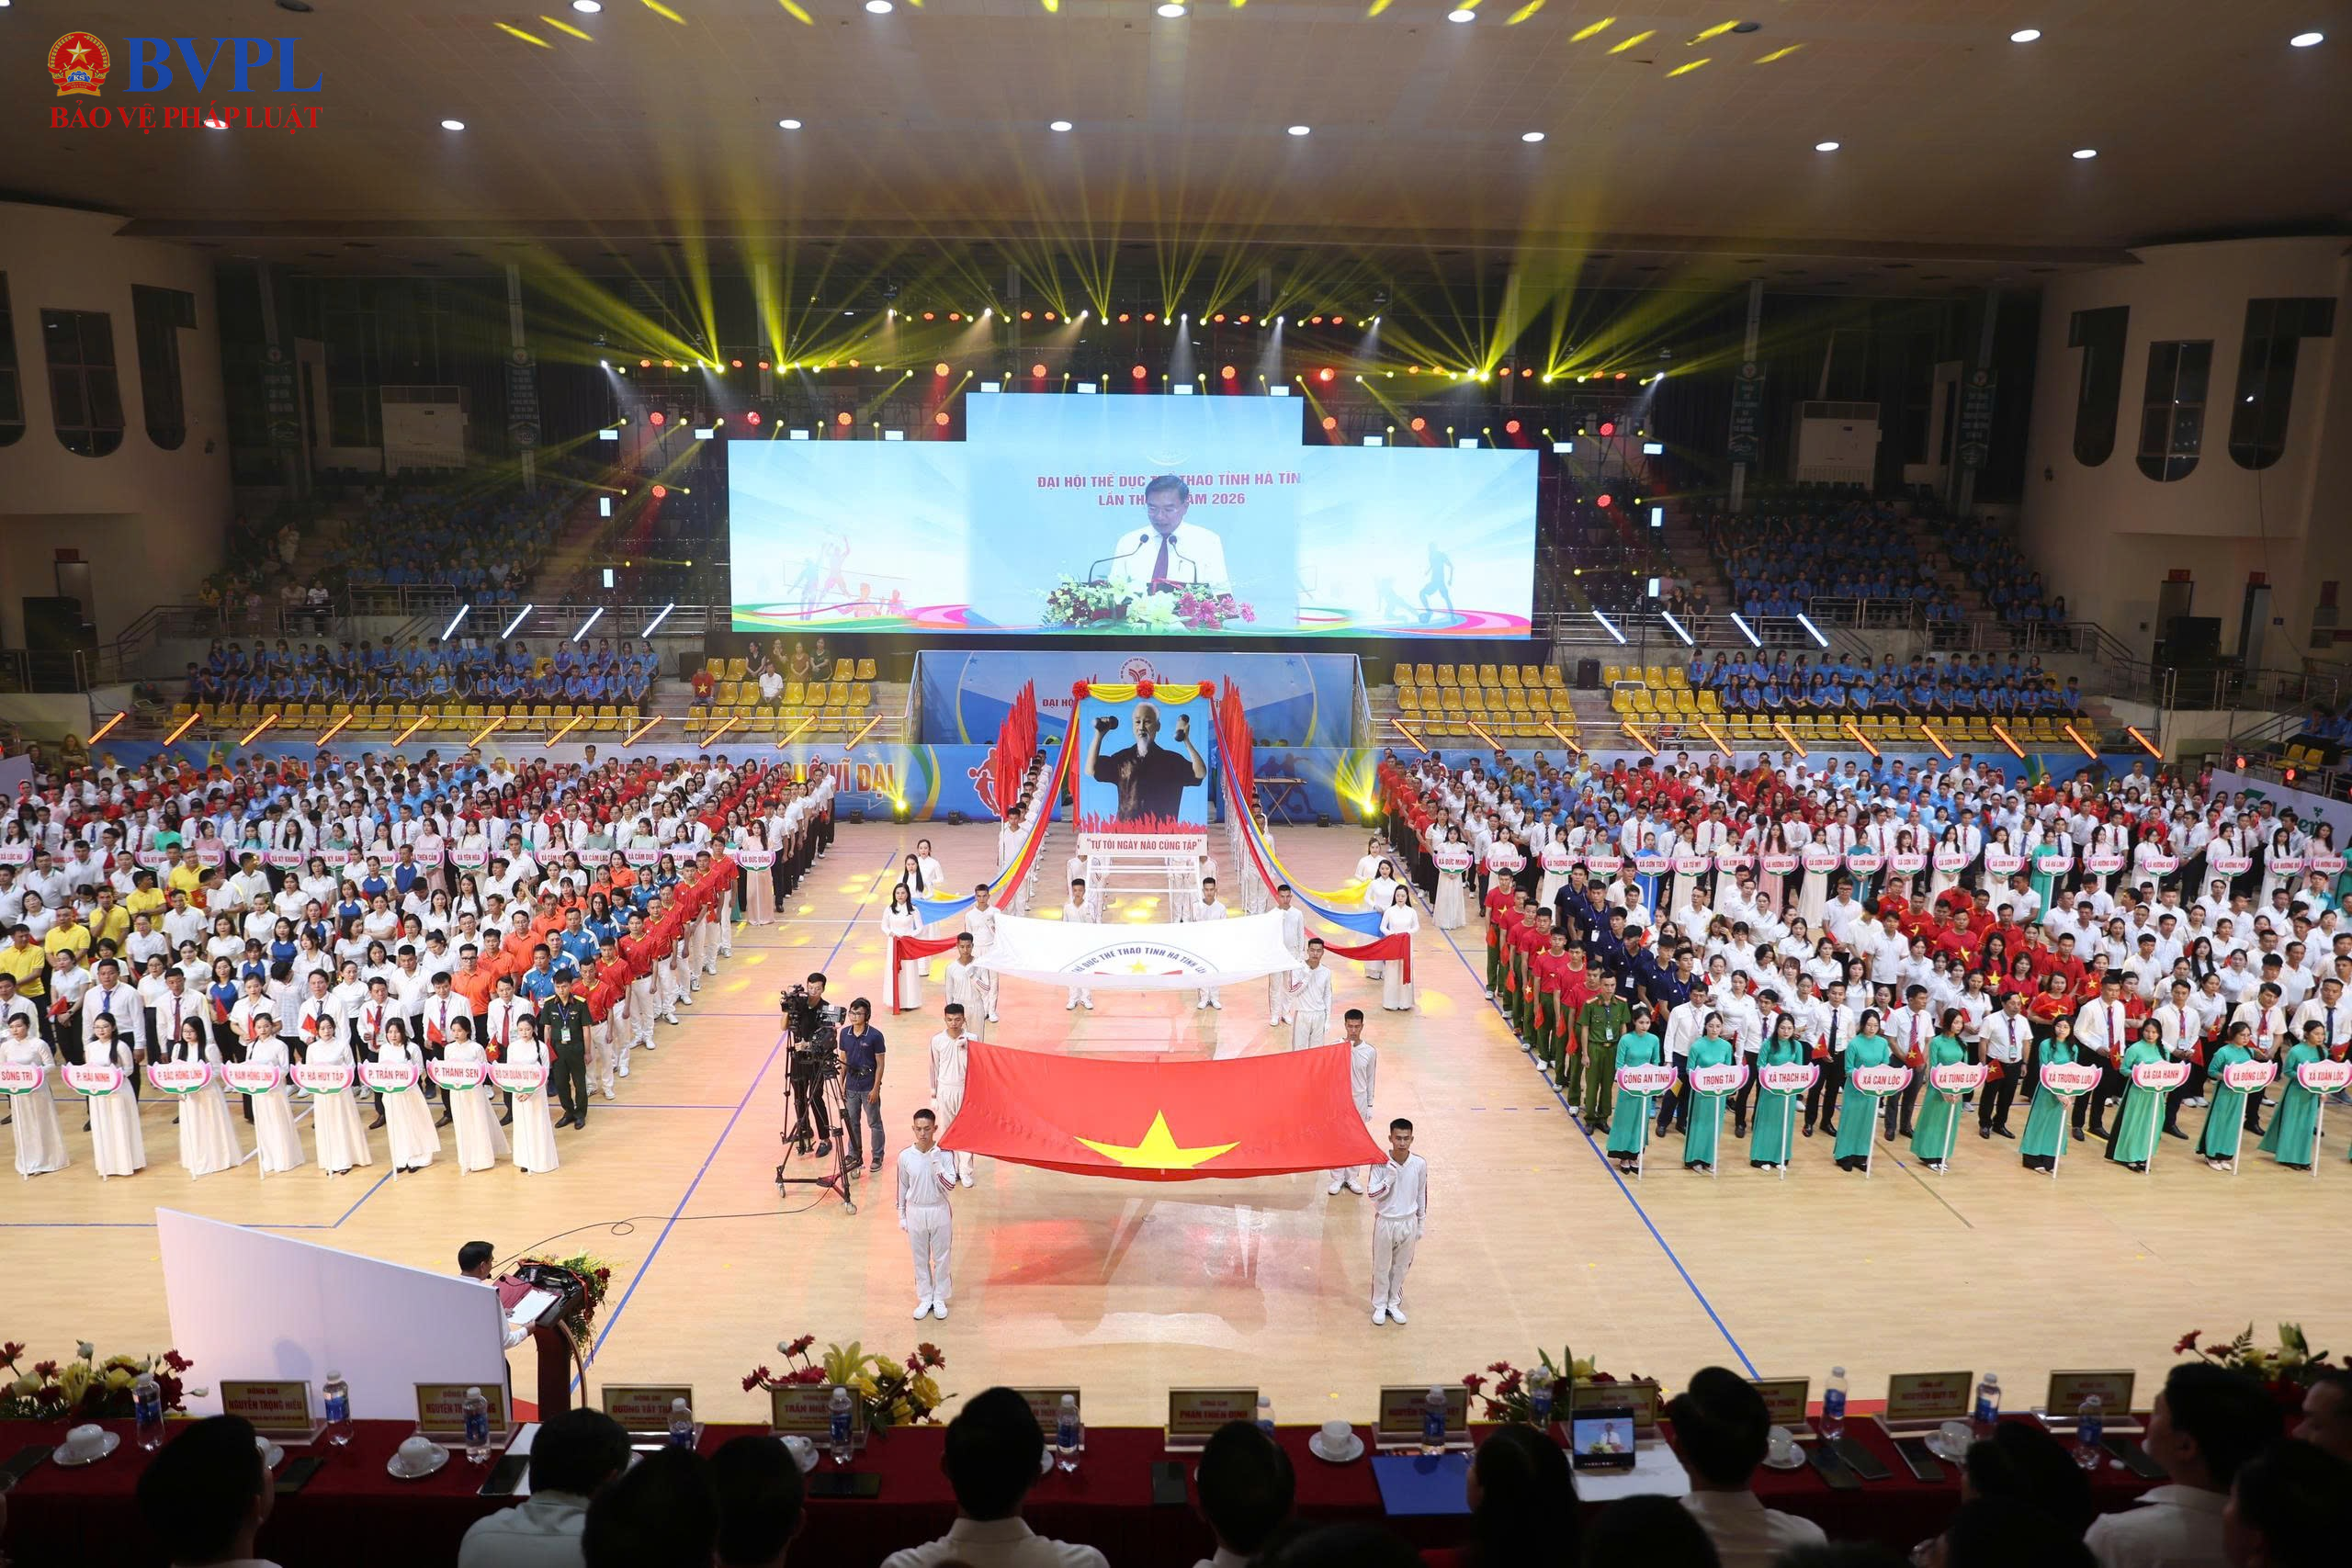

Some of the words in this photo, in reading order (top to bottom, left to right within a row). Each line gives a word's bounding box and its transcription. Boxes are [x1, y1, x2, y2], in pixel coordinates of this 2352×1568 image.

[1037, 476, 1059, 490] ĐẠI
[1064, 474, 1086, 490] HỘI
[1091, 471, 1114, 487] THỂ
[1119, 475, 1146, 489] DỤC
[1218, 470, 1250, 485] TỈNH
[1255, 471, 1273, 485] HÀ
[1098, 491, 1124, 505] LẦN
[1129, 494, 1147, 505] TH
[1212, 493, 1245, 504] 2026
[1042, 698, 1058, 708] ĐẠI
[856, 763, 895, 798] ĐẠI
[1103, 839, 1114, 850] TÔI
[1117, 838, 1138, 850] NGÀY
[1140, 839, 1157, 850] NÀO
[1159, 839, 1181, 850] CŨNG
[1117, 947, 1141, 956] THAO
[300, 1071, 307, 1081] P.
[318, 1071, 331, 1081] HUY
[368, 1069, 375, 1080] P.
[435, 1066, 441, 1077] P.
[466, 1067, 479, 1078] SEN
[1623, 1072, 1642, 1084] CÔNG
[1643, 1073, 1653, 1083] AN
[1654, 1070, 1670, 1083] TỈNH
[1769, 1071, 1777, 1083] XÃ
[1939, 1071, 1947, 1083] XÃ
[2048, 1071, 2056, 1082] XÃ
[2143, 1068, 2151, 1079] XÃ
[2152, 1070, 2162, 1078] GIA
[2308, 1070, 2315, 1081] XÃ
[1725, 1073, 1736, 1084] TÀI
[1862, 1073, 1871, 1085] XÃ
[1872, 1076, 1886, 1085] CAN
[1887, 1073, 1901, 1087] LỘC
[229, 1397, 257, 1410] NGUYỄN
[258, 1399, 283, 1411] TRỌNG
